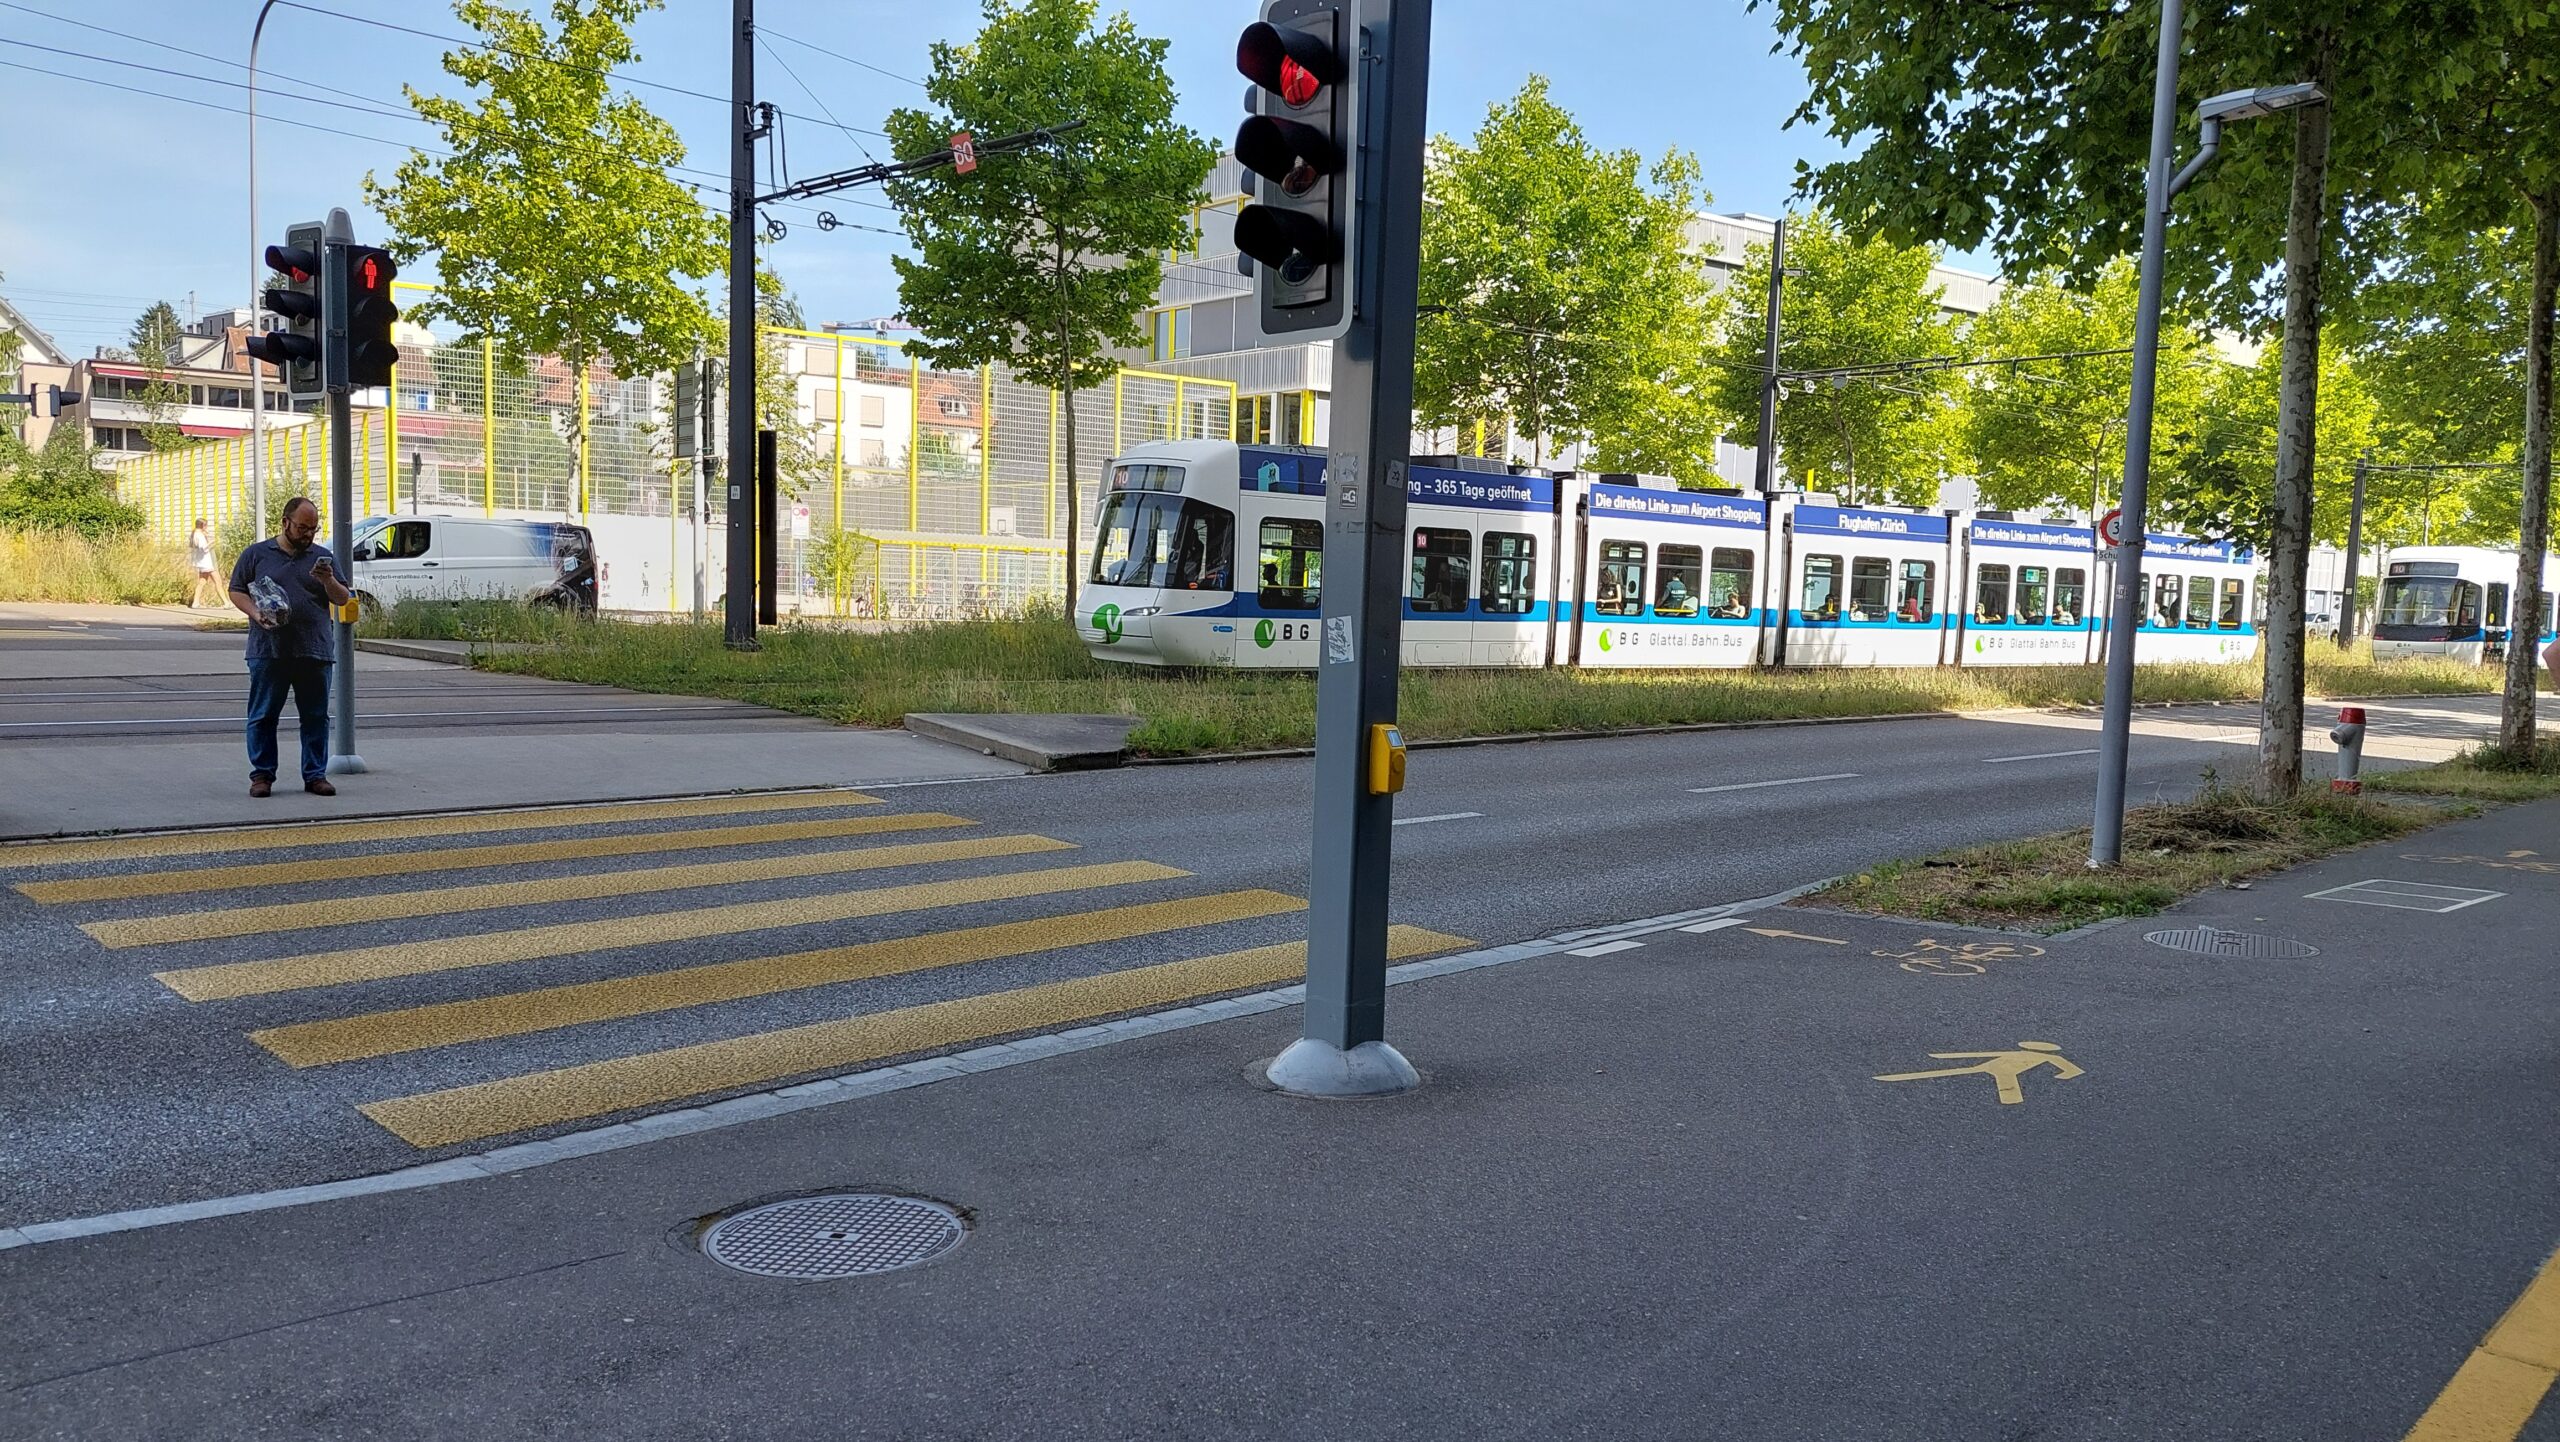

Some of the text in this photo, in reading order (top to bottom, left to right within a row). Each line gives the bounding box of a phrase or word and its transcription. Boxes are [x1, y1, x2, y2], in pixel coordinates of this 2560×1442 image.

[953, 141, 974, 165] 60
[1408, 481, 1421, 495] ng
[1435, 479, 1457, 494] 365
[1460, 481, 1485, 499] Tage
[1487, 485, 1531, 501] geöffnet
[1595, 492, 1762, 524] Die direkte Linie zum Airport Shopping
[1839, 513, 1908, 534] Flughafen Zürich
[2112, 523, 2120, 534] 3
[1974, 526, 2091, 548] Die direkte Linie zum Airport Shopping
[2098, 549, 2119, 560] Schu
